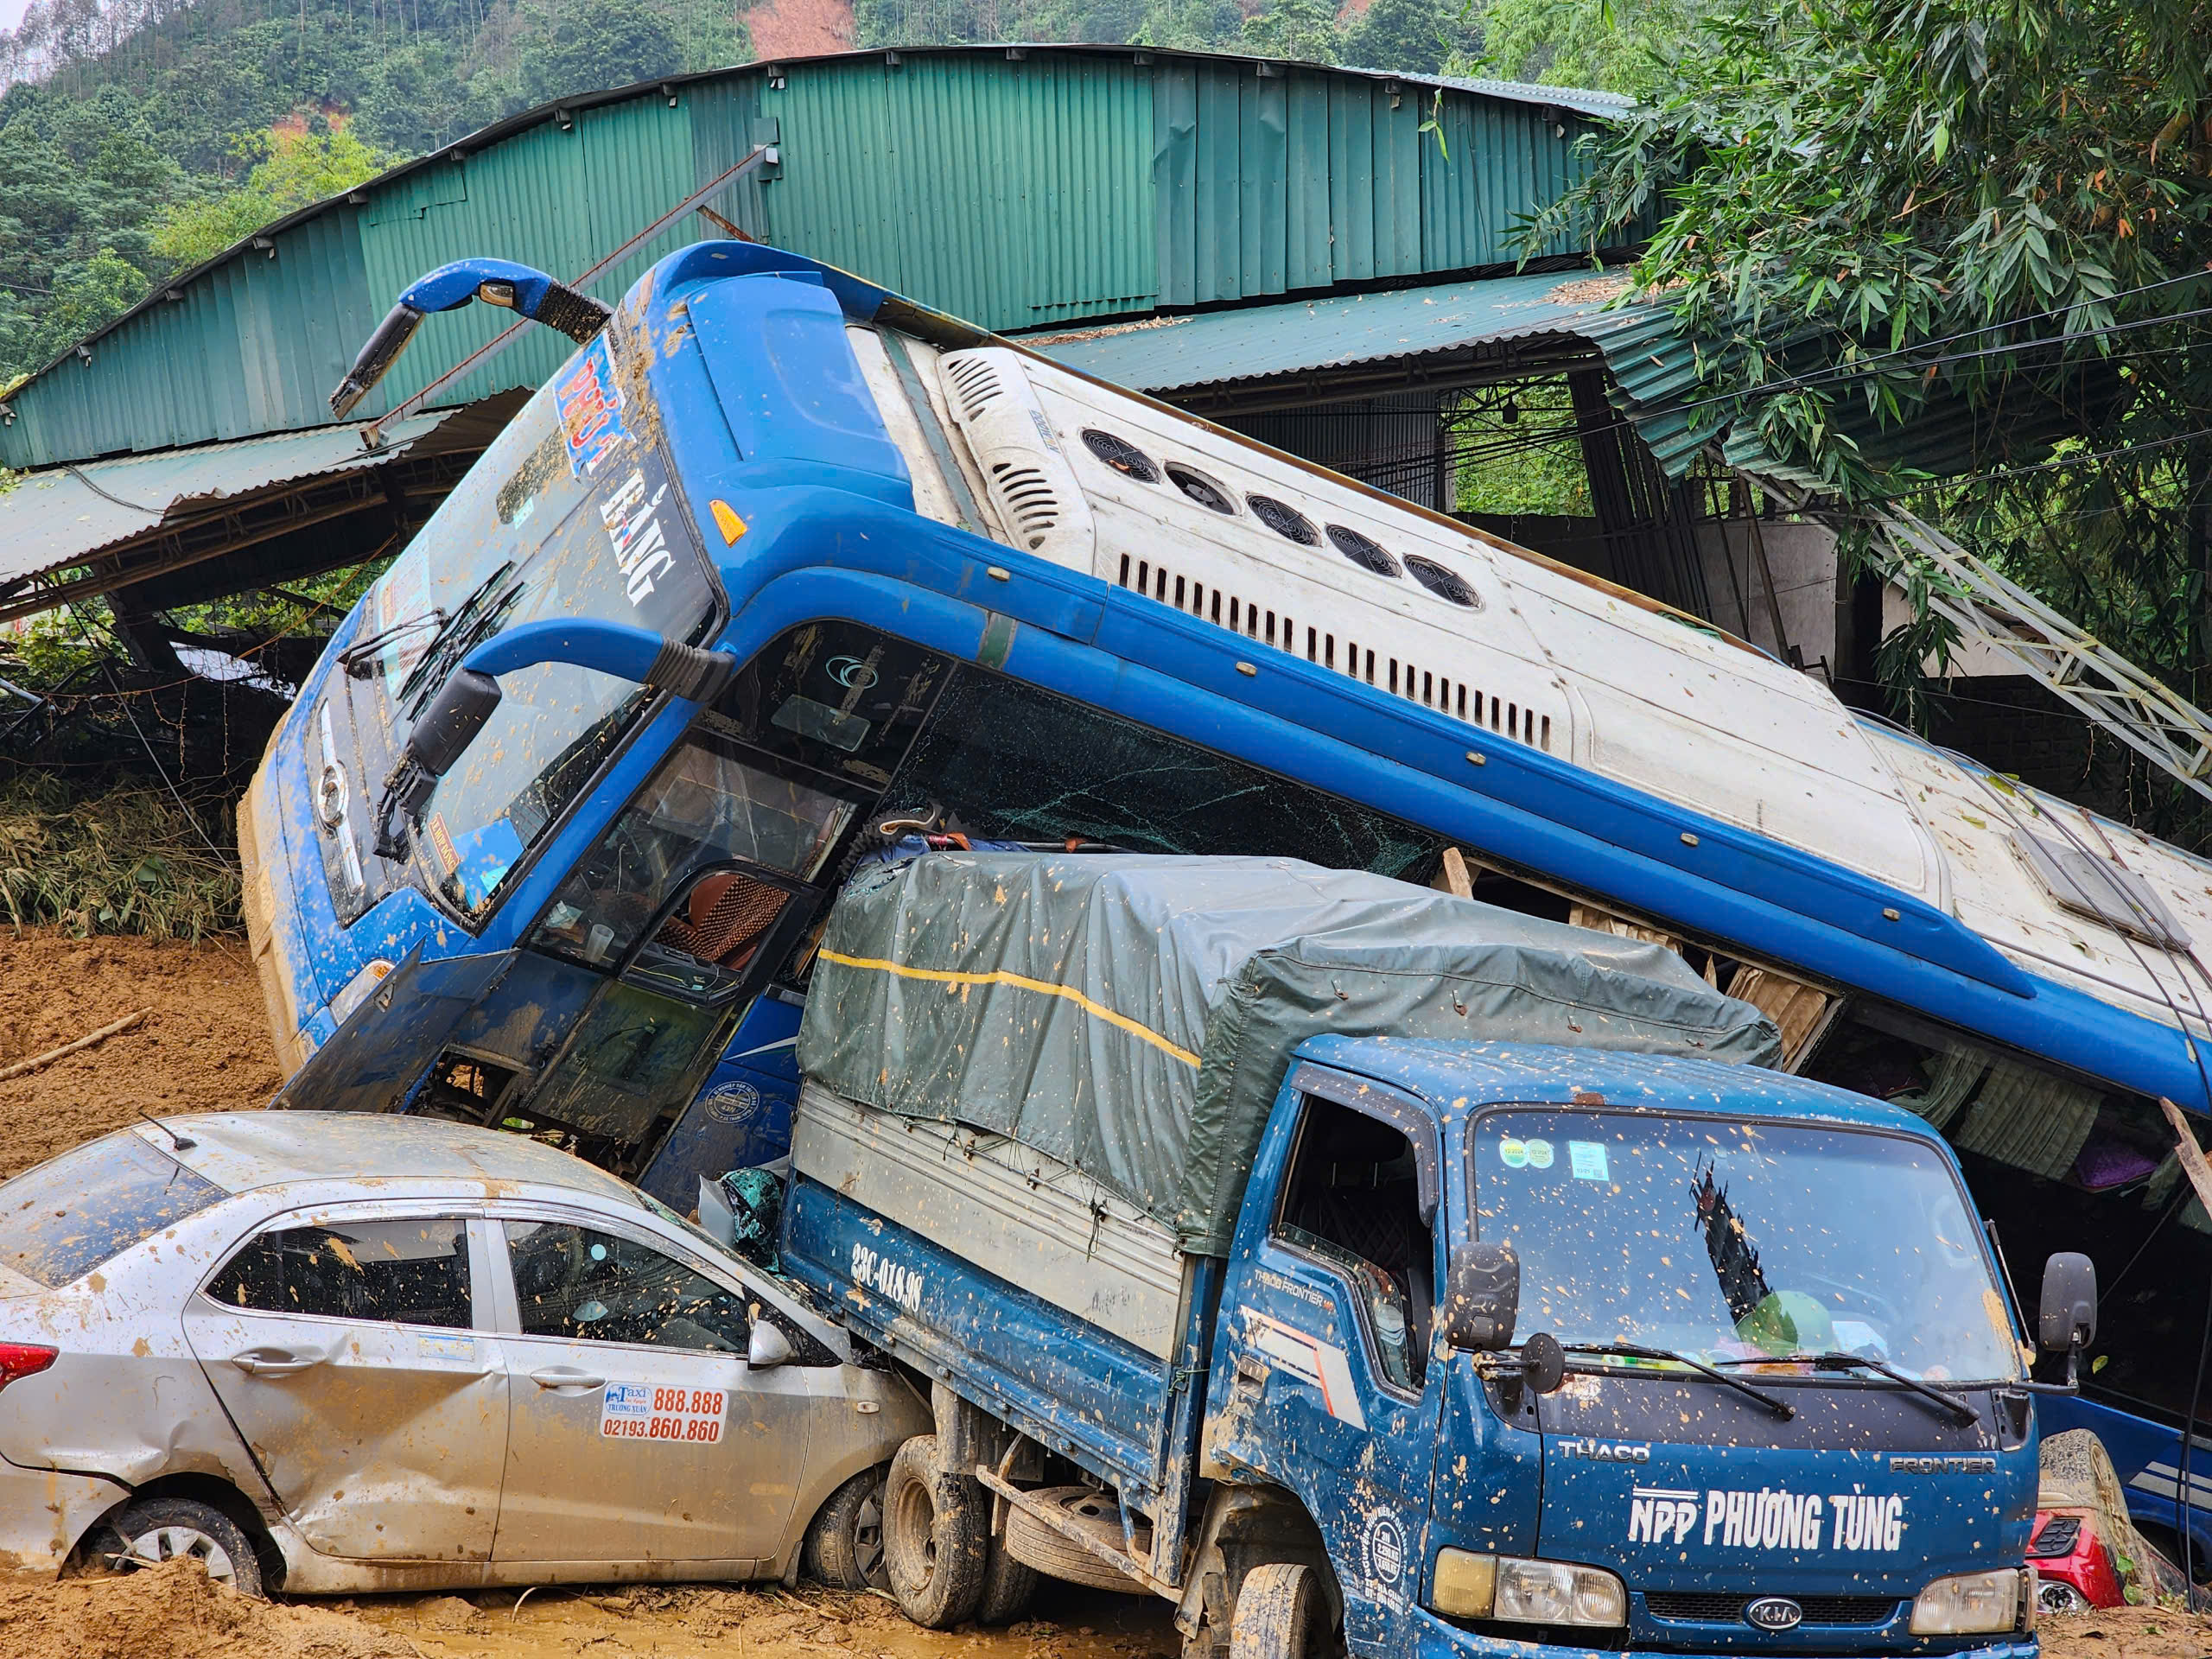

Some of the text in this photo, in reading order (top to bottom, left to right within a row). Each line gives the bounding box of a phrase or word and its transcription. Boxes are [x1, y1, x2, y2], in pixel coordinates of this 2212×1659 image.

[1281, 1280, 1324, 1307] FRONTIER
[618, 1386, 723, 1415] Taxi 888.888
[603, 1417, 720, 1442] 02193.860.860
[1558, 1441, 1650, 1464] THACO
[1890, 1458, 1997, 1475] FRONTIER
[1629, 1484, 1904, 1552] NPP PHƯƠNG TÙNG
[1759, 1605, 1794, 1622] KIA
